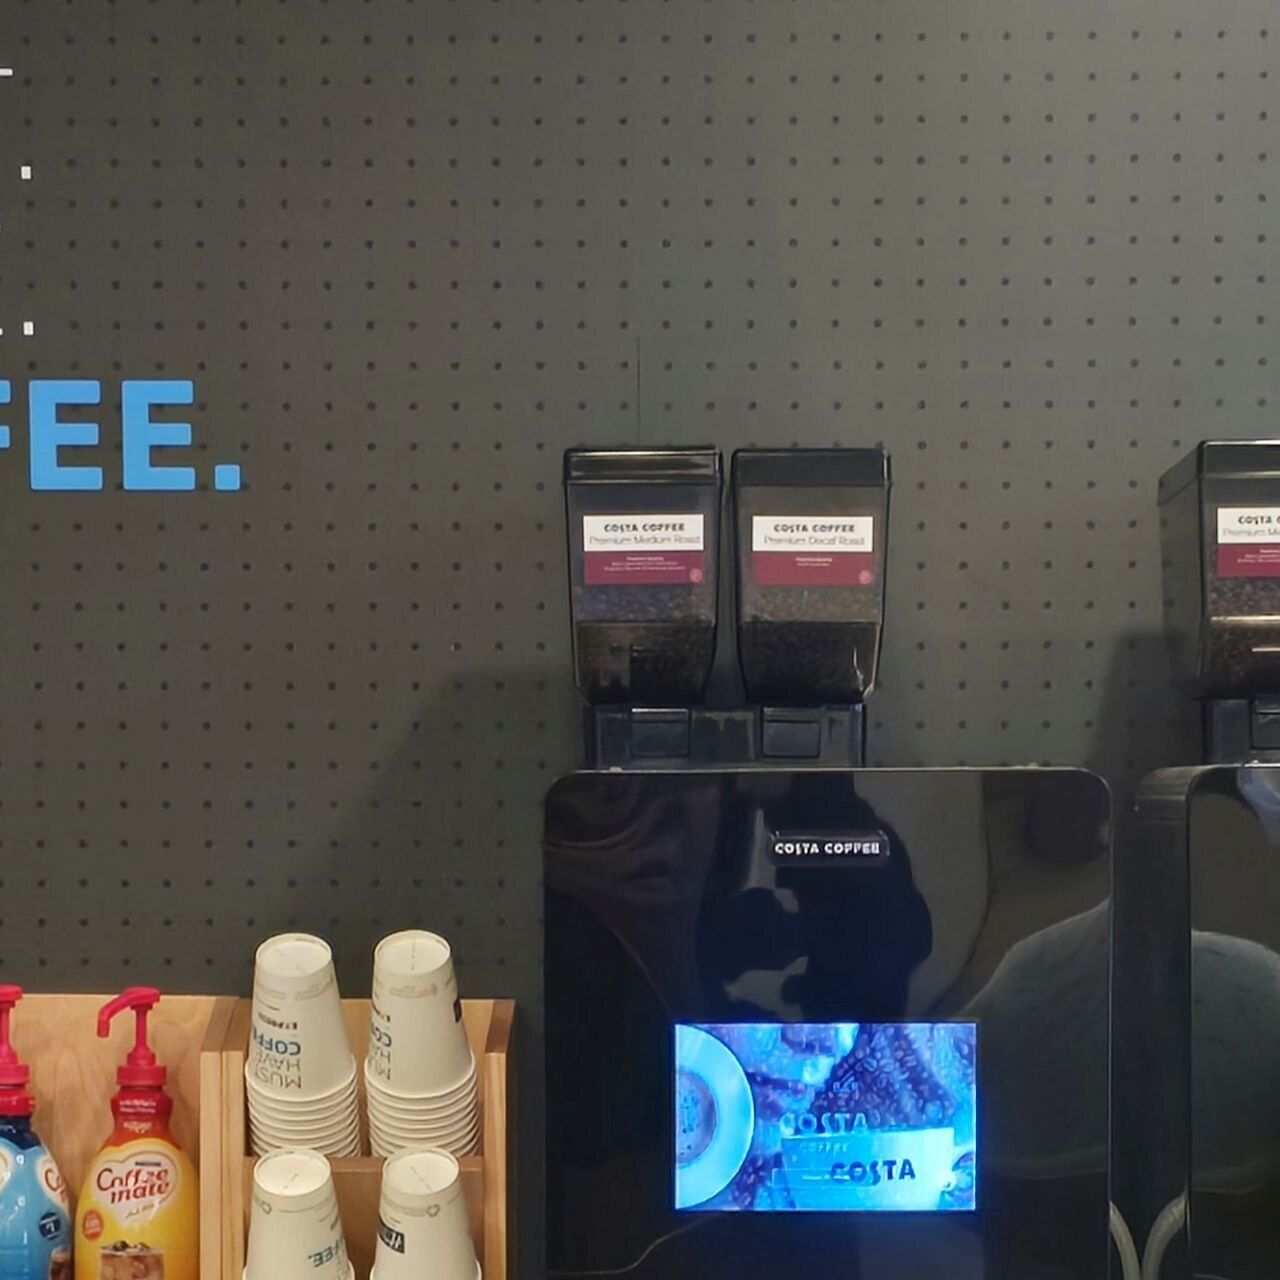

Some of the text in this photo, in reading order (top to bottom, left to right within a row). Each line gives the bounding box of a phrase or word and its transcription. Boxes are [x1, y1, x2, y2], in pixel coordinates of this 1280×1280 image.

[775, 842, 880, 855] COSTA COFFEE
[780, 1112, 868, 1135] COSTA
[96, 1167, 170, 1192] Coffee
[831, 1158, 916, 1185] COSTA
